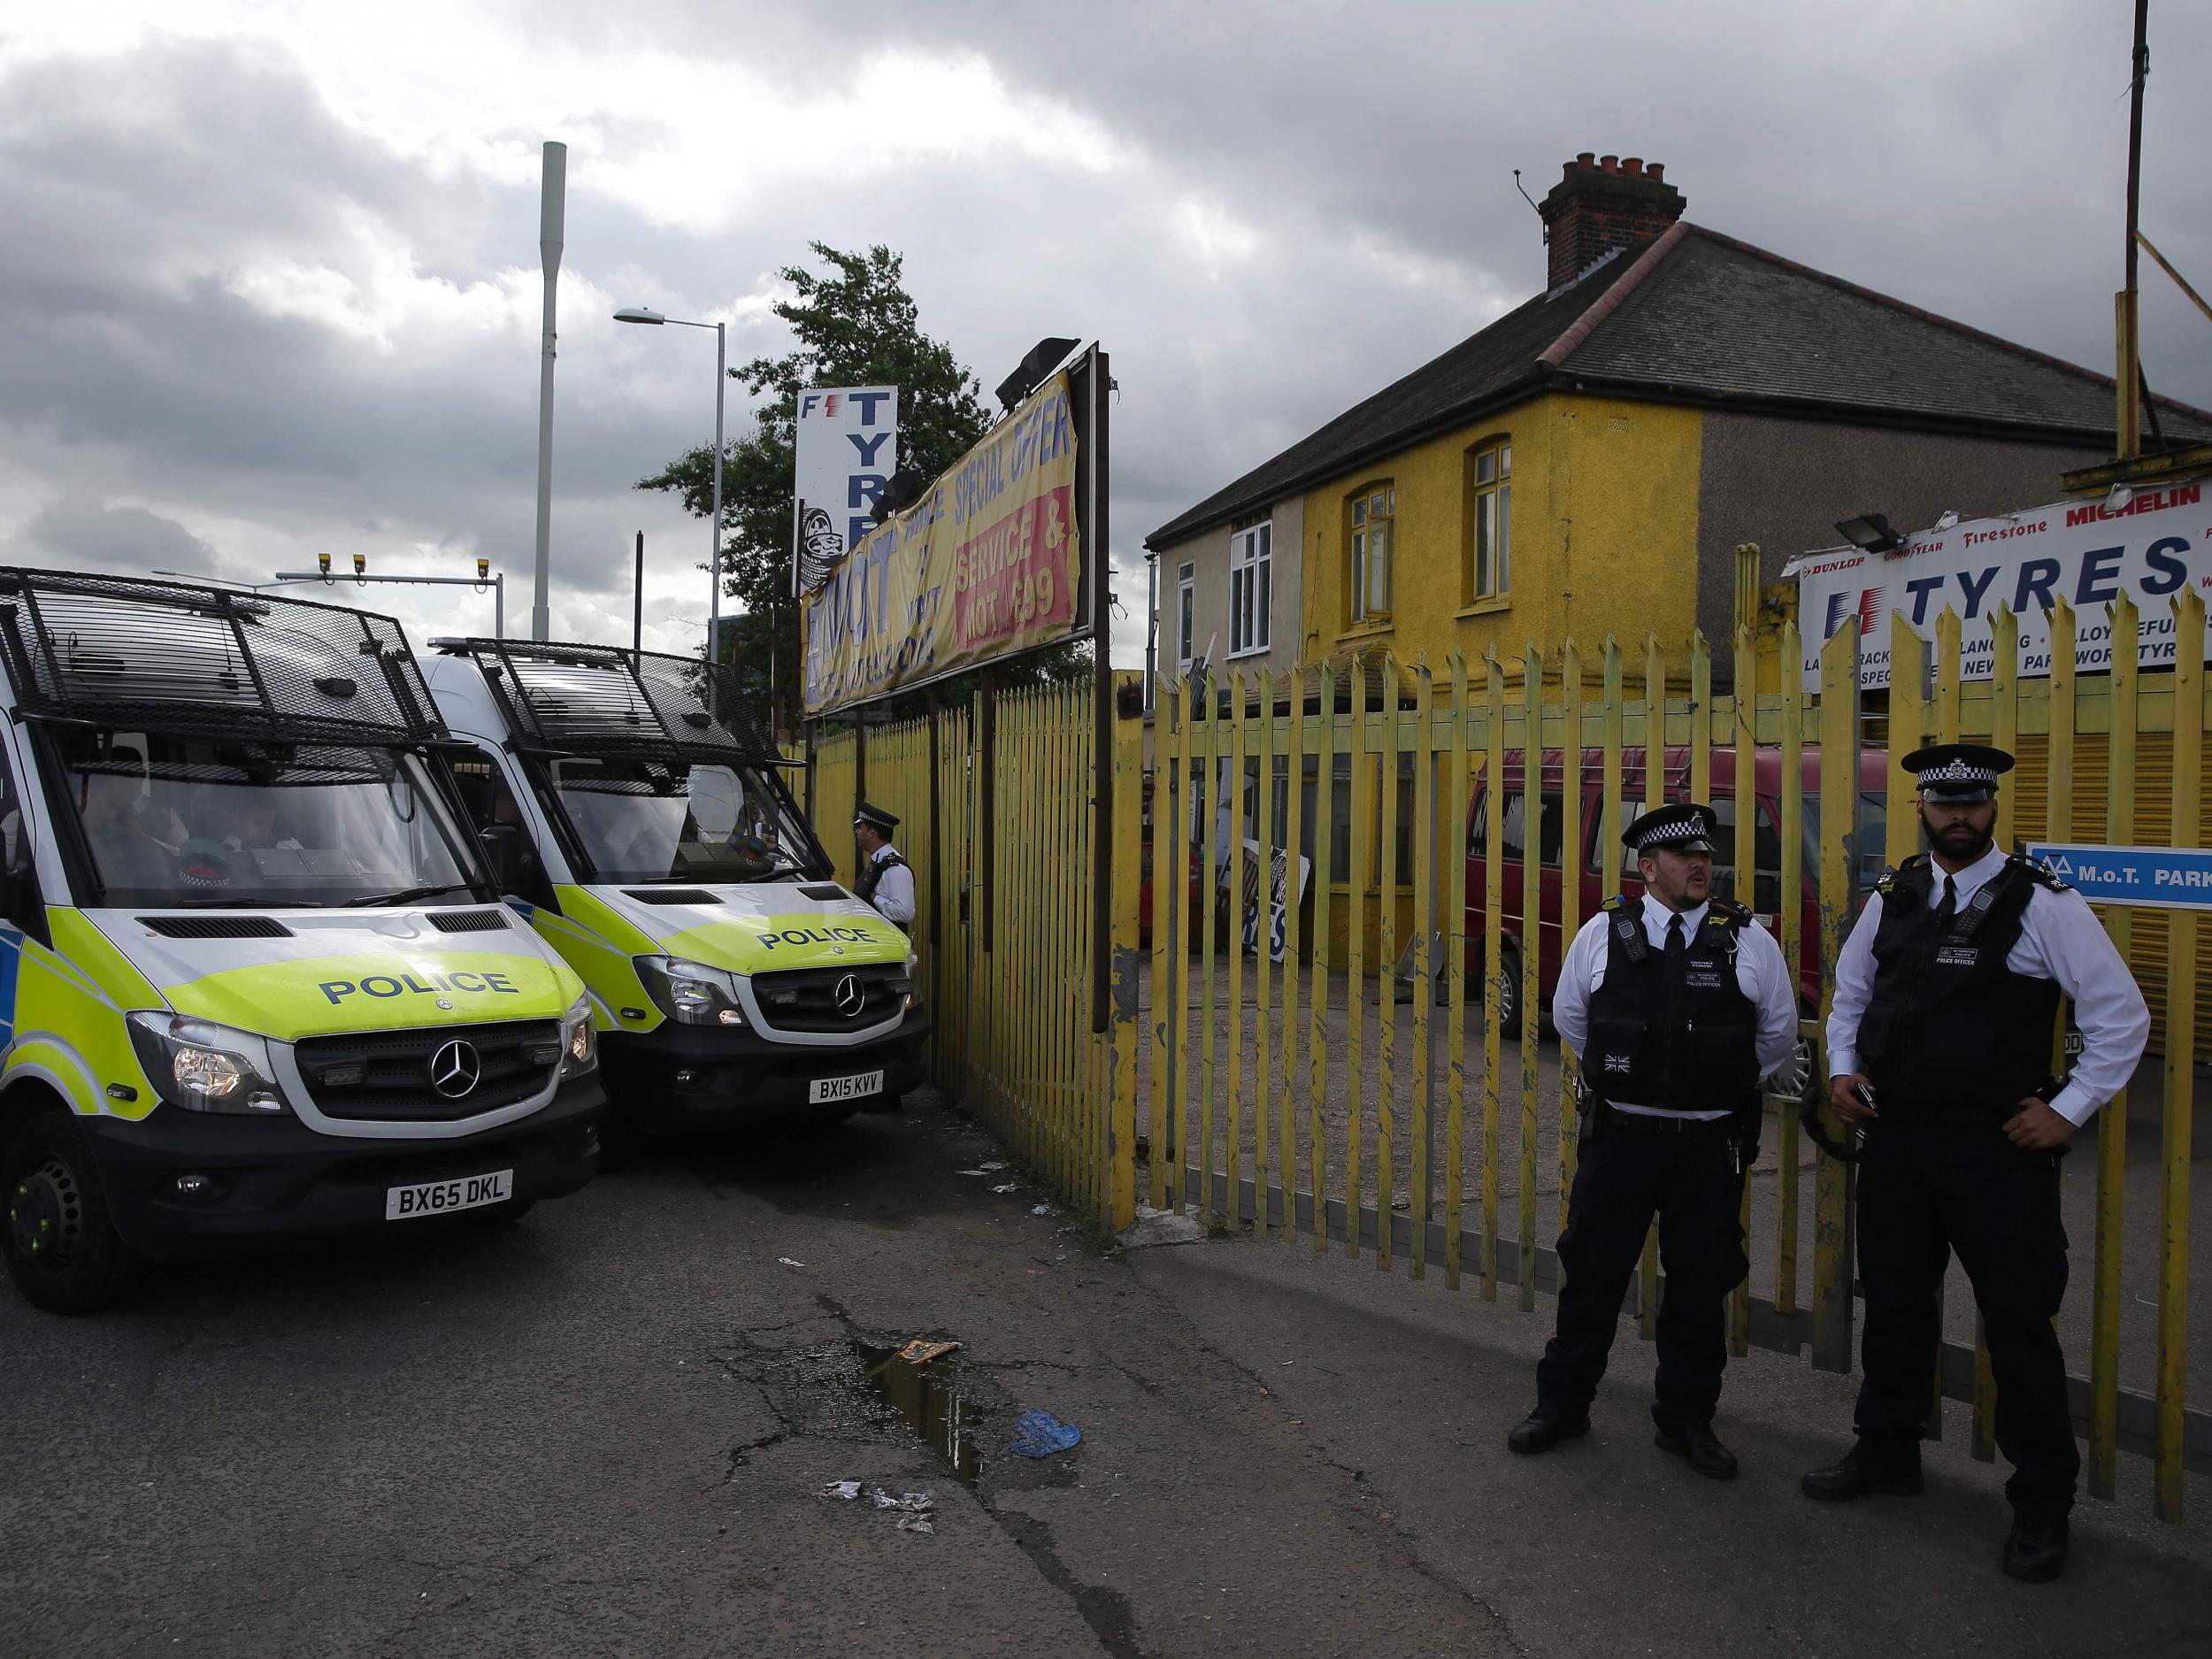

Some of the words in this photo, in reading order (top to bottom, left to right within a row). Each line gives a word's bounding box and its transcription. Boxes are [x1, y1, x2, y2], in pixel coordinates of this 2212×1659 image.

[956, 441, 1005, 526] SPECIAL
[1011, 390, 1071, 483] OFFER
[956, 510, 1033, 594] SERVICE
[1045, 499, 1067, 549] &
[1963, 520, 2047, 549] Firestone
[1812, 557, 1864, 575] DUNLOP
[1906, 536, 2192, 626] TYRES
[965, 589, 999, 642] MOT
[756, 927, 879, 950] POLICE
[319, 971, 520, 1005] POLICE
[820, 1079, 852, 1099] BX15
[855, 1073, 878, 1094] KVV
[399, 1182, 461, 1214] BX65
[466, 1175, 504, 1204] DKL
